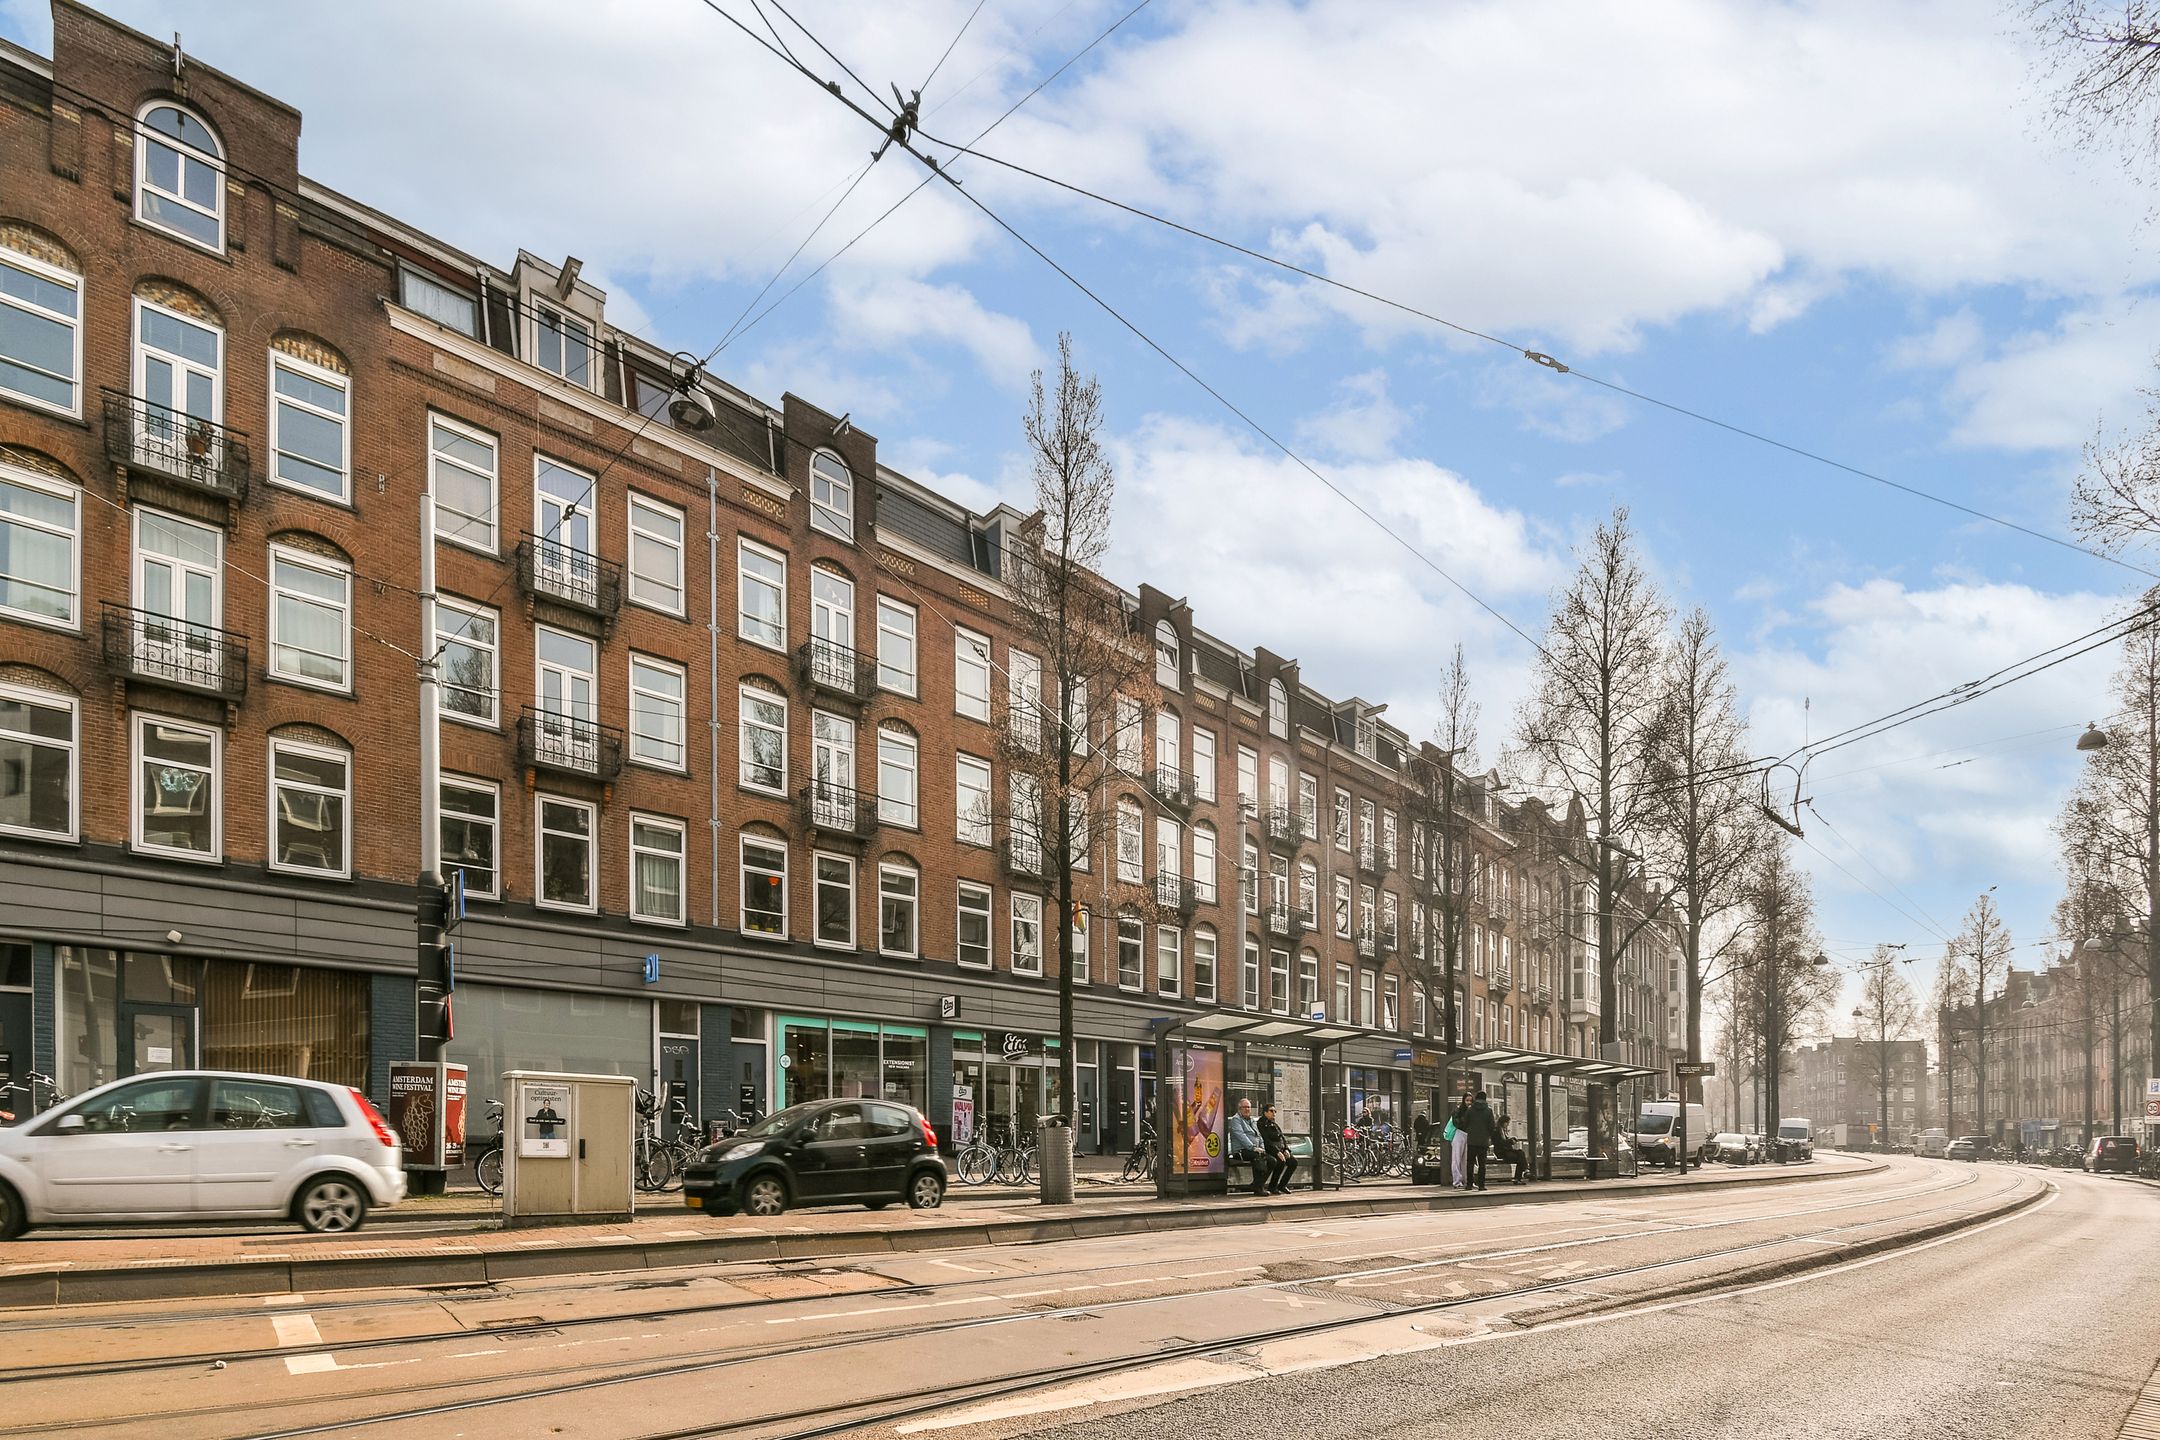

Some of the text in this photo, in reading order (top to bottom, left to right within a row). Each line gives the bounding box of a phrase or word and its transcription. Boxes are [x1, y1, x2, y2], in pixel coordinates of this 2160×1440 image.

[1003, 1032, 1028, 1062] Etos
[392, 1075, 434, 1084] AMSTERDAM
[392, 1083, 434, 1092] WINE FESTIVAL
